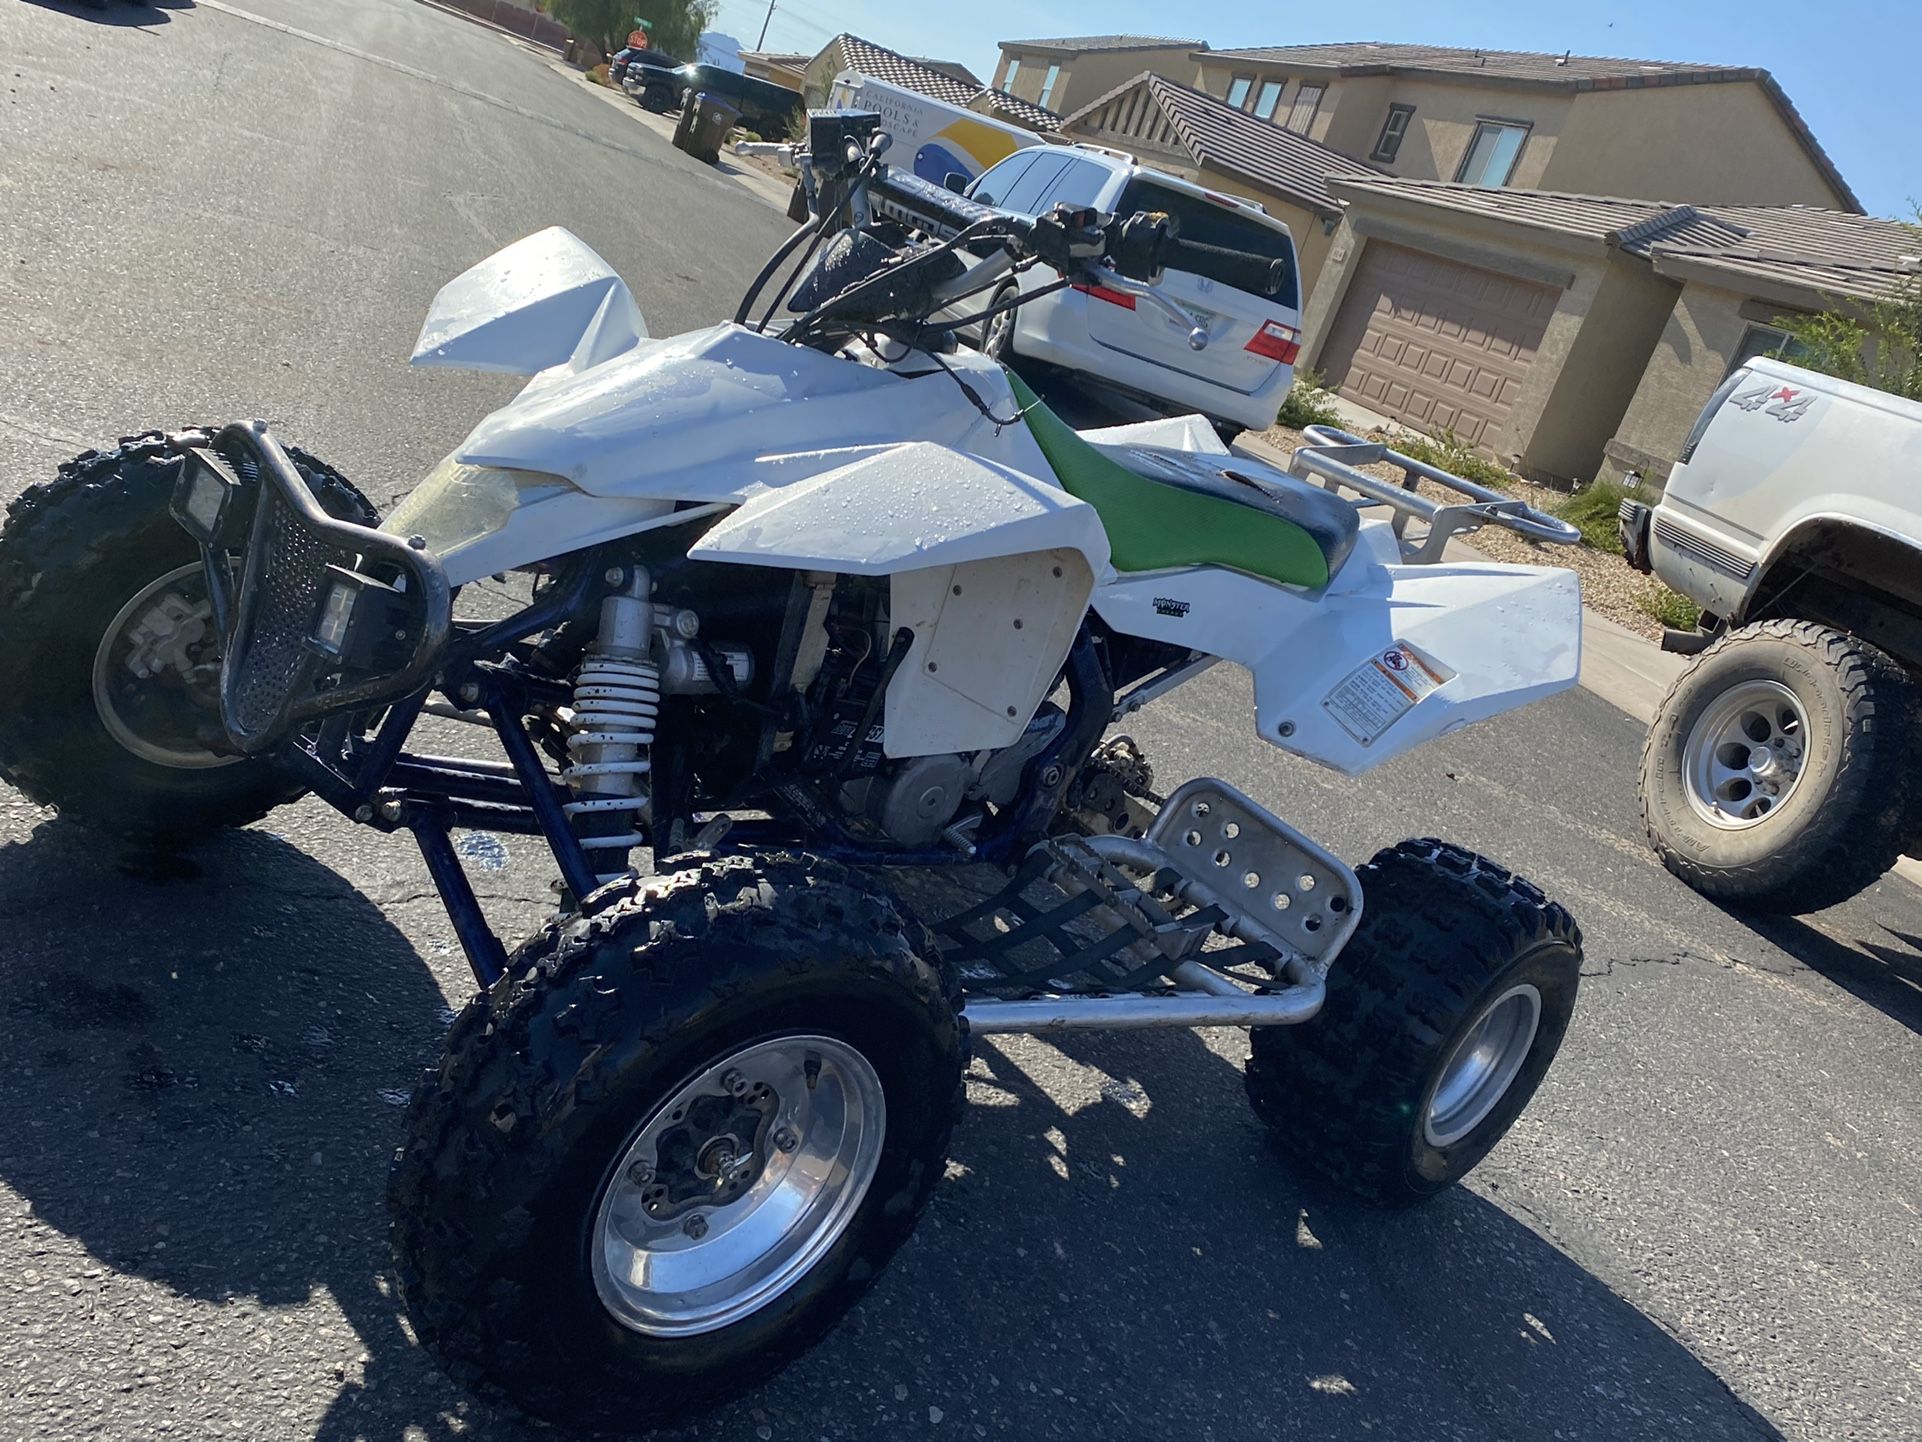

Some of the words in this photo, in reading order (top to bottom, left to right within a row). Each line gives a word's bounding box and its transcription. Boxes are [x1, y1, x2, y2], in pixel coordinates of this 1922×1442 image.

[630, 34, 647, 48] STOP
[864, 100, 910, 125] POOLS
[866, 90, 923, 116] CALIFORNIA
